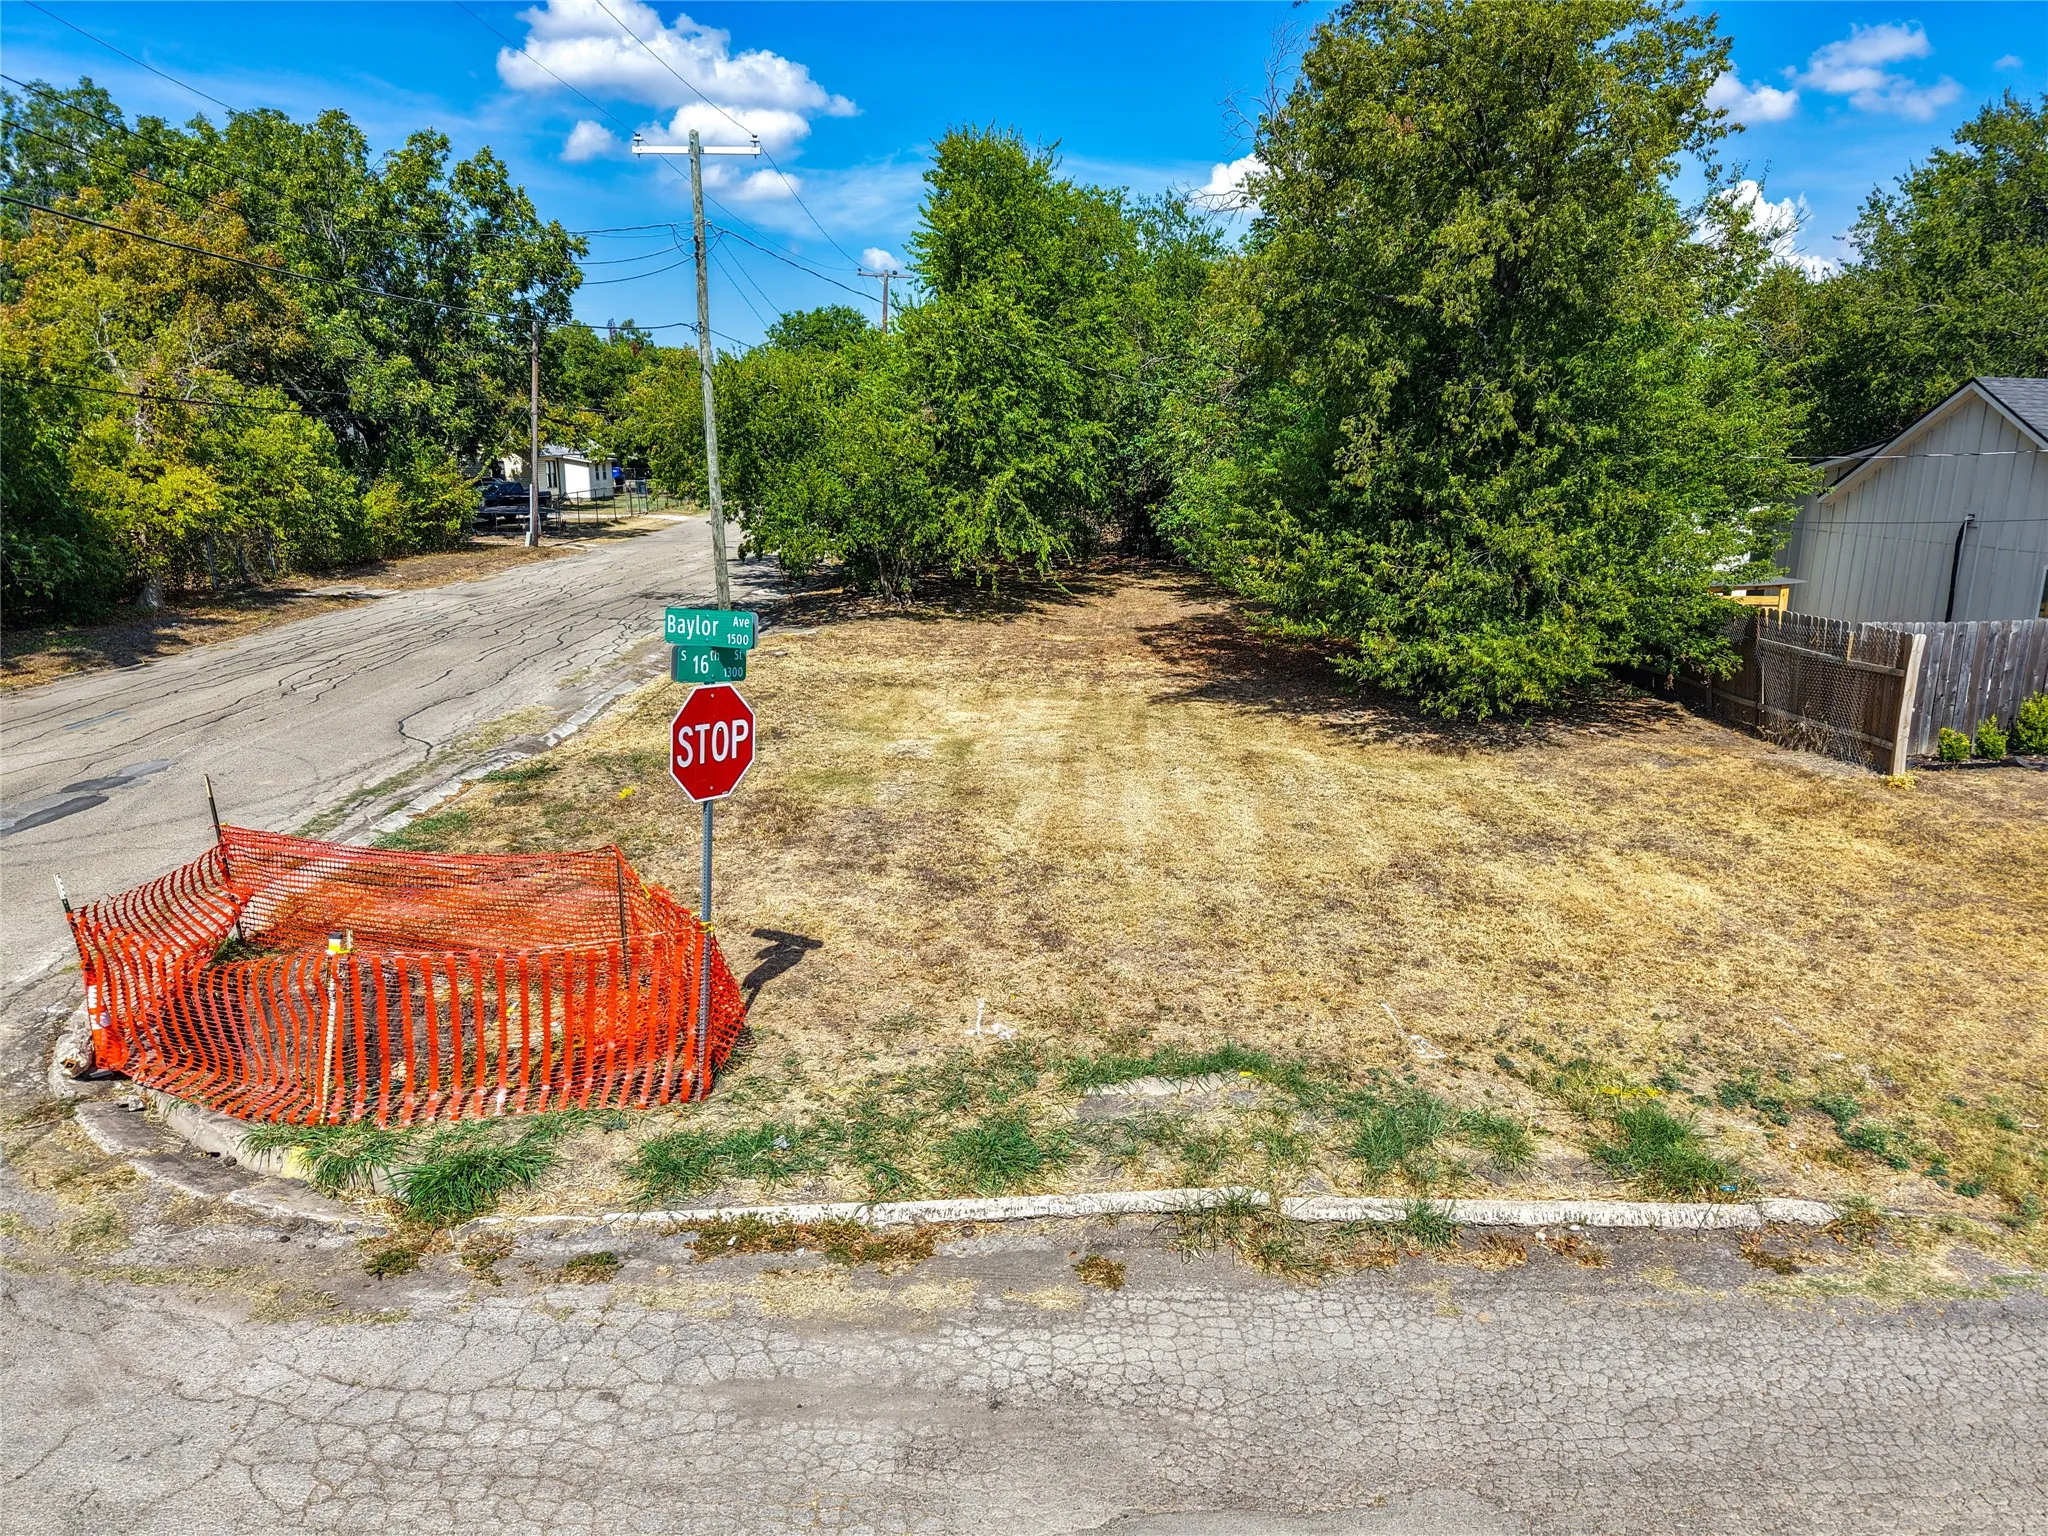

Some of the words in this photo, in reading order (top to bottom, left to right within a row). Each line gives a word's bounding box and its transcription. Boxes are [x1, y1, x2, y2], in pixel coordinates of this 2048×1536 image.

[667, 614, 719, 640] Baylor
[732, 616, 750, 628] Ave
[727, 633, 749, 645] 1500
[681, 650, 687, 661] S
[734, 649, 743, 660] St
[723, 666, 744, 678] 1300
[676, 719, 749, 768] STOP
